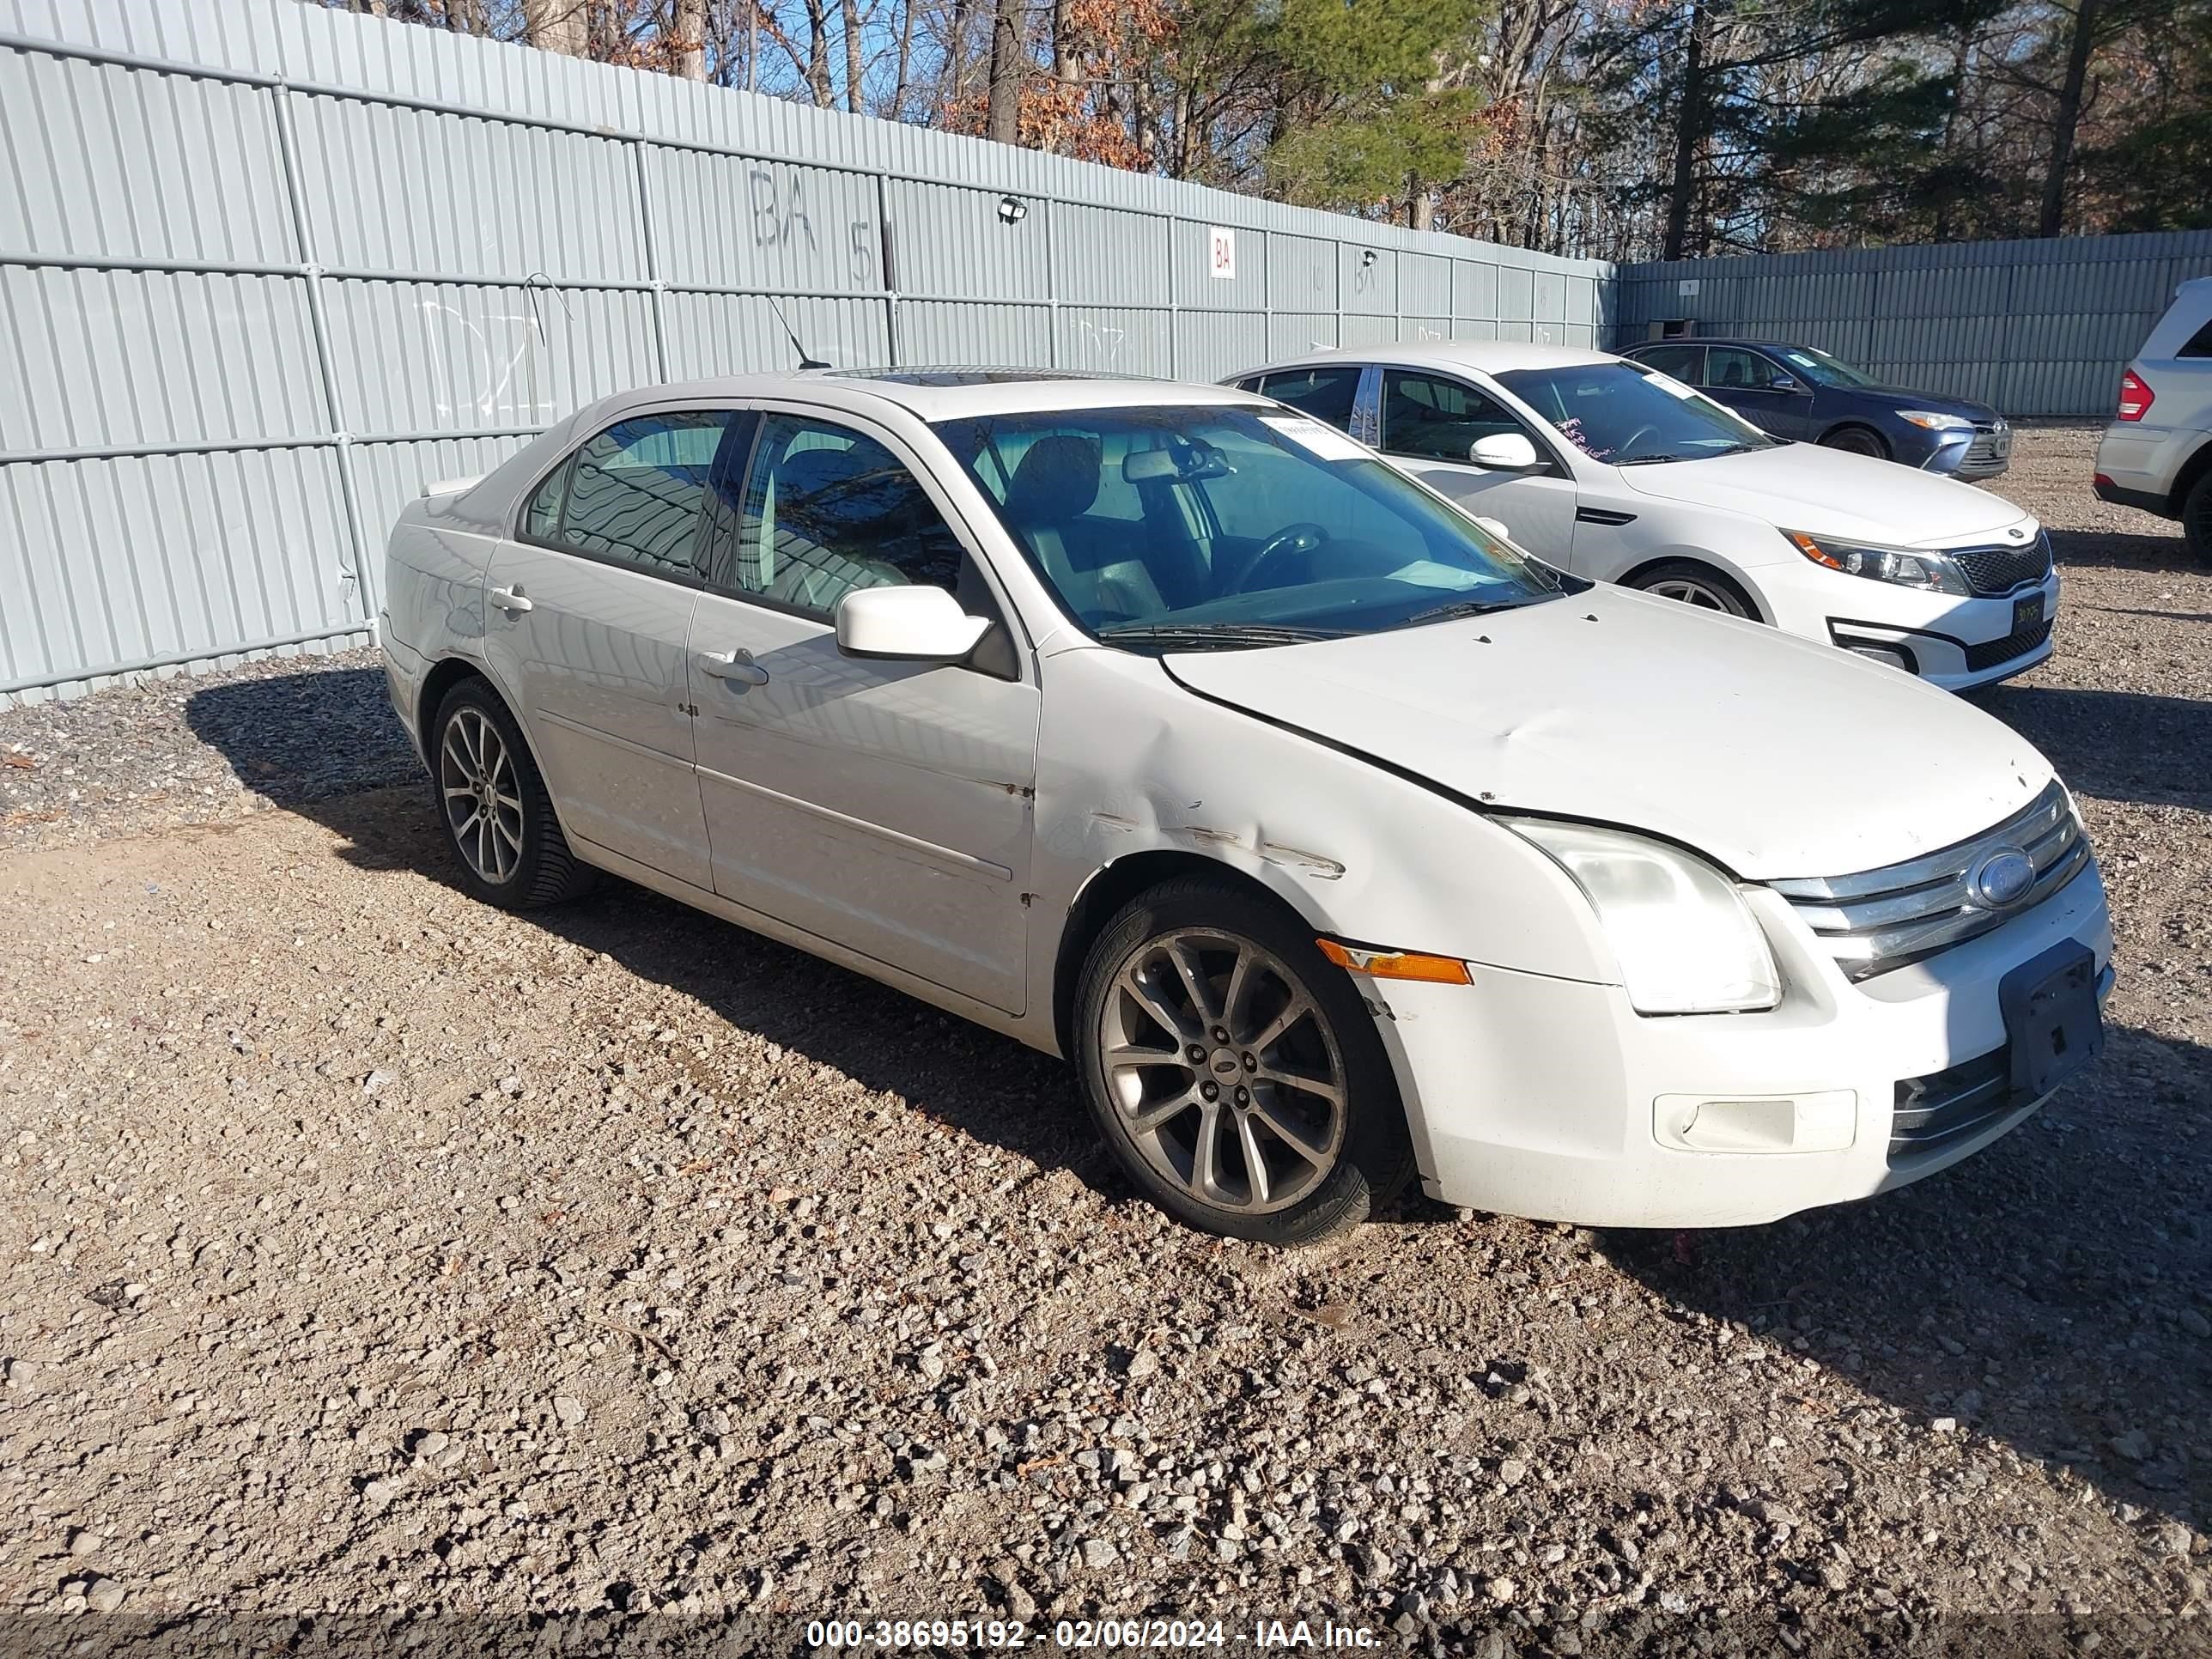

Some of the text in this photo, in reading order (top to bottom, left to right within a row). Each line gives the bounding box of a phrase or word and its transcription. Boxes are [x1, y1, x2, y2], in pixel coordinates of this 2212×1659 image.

[750, 170, 817, 252] BA
[851, 221, 872, 282] 5
[1215, 238, 1231, 270] BA
